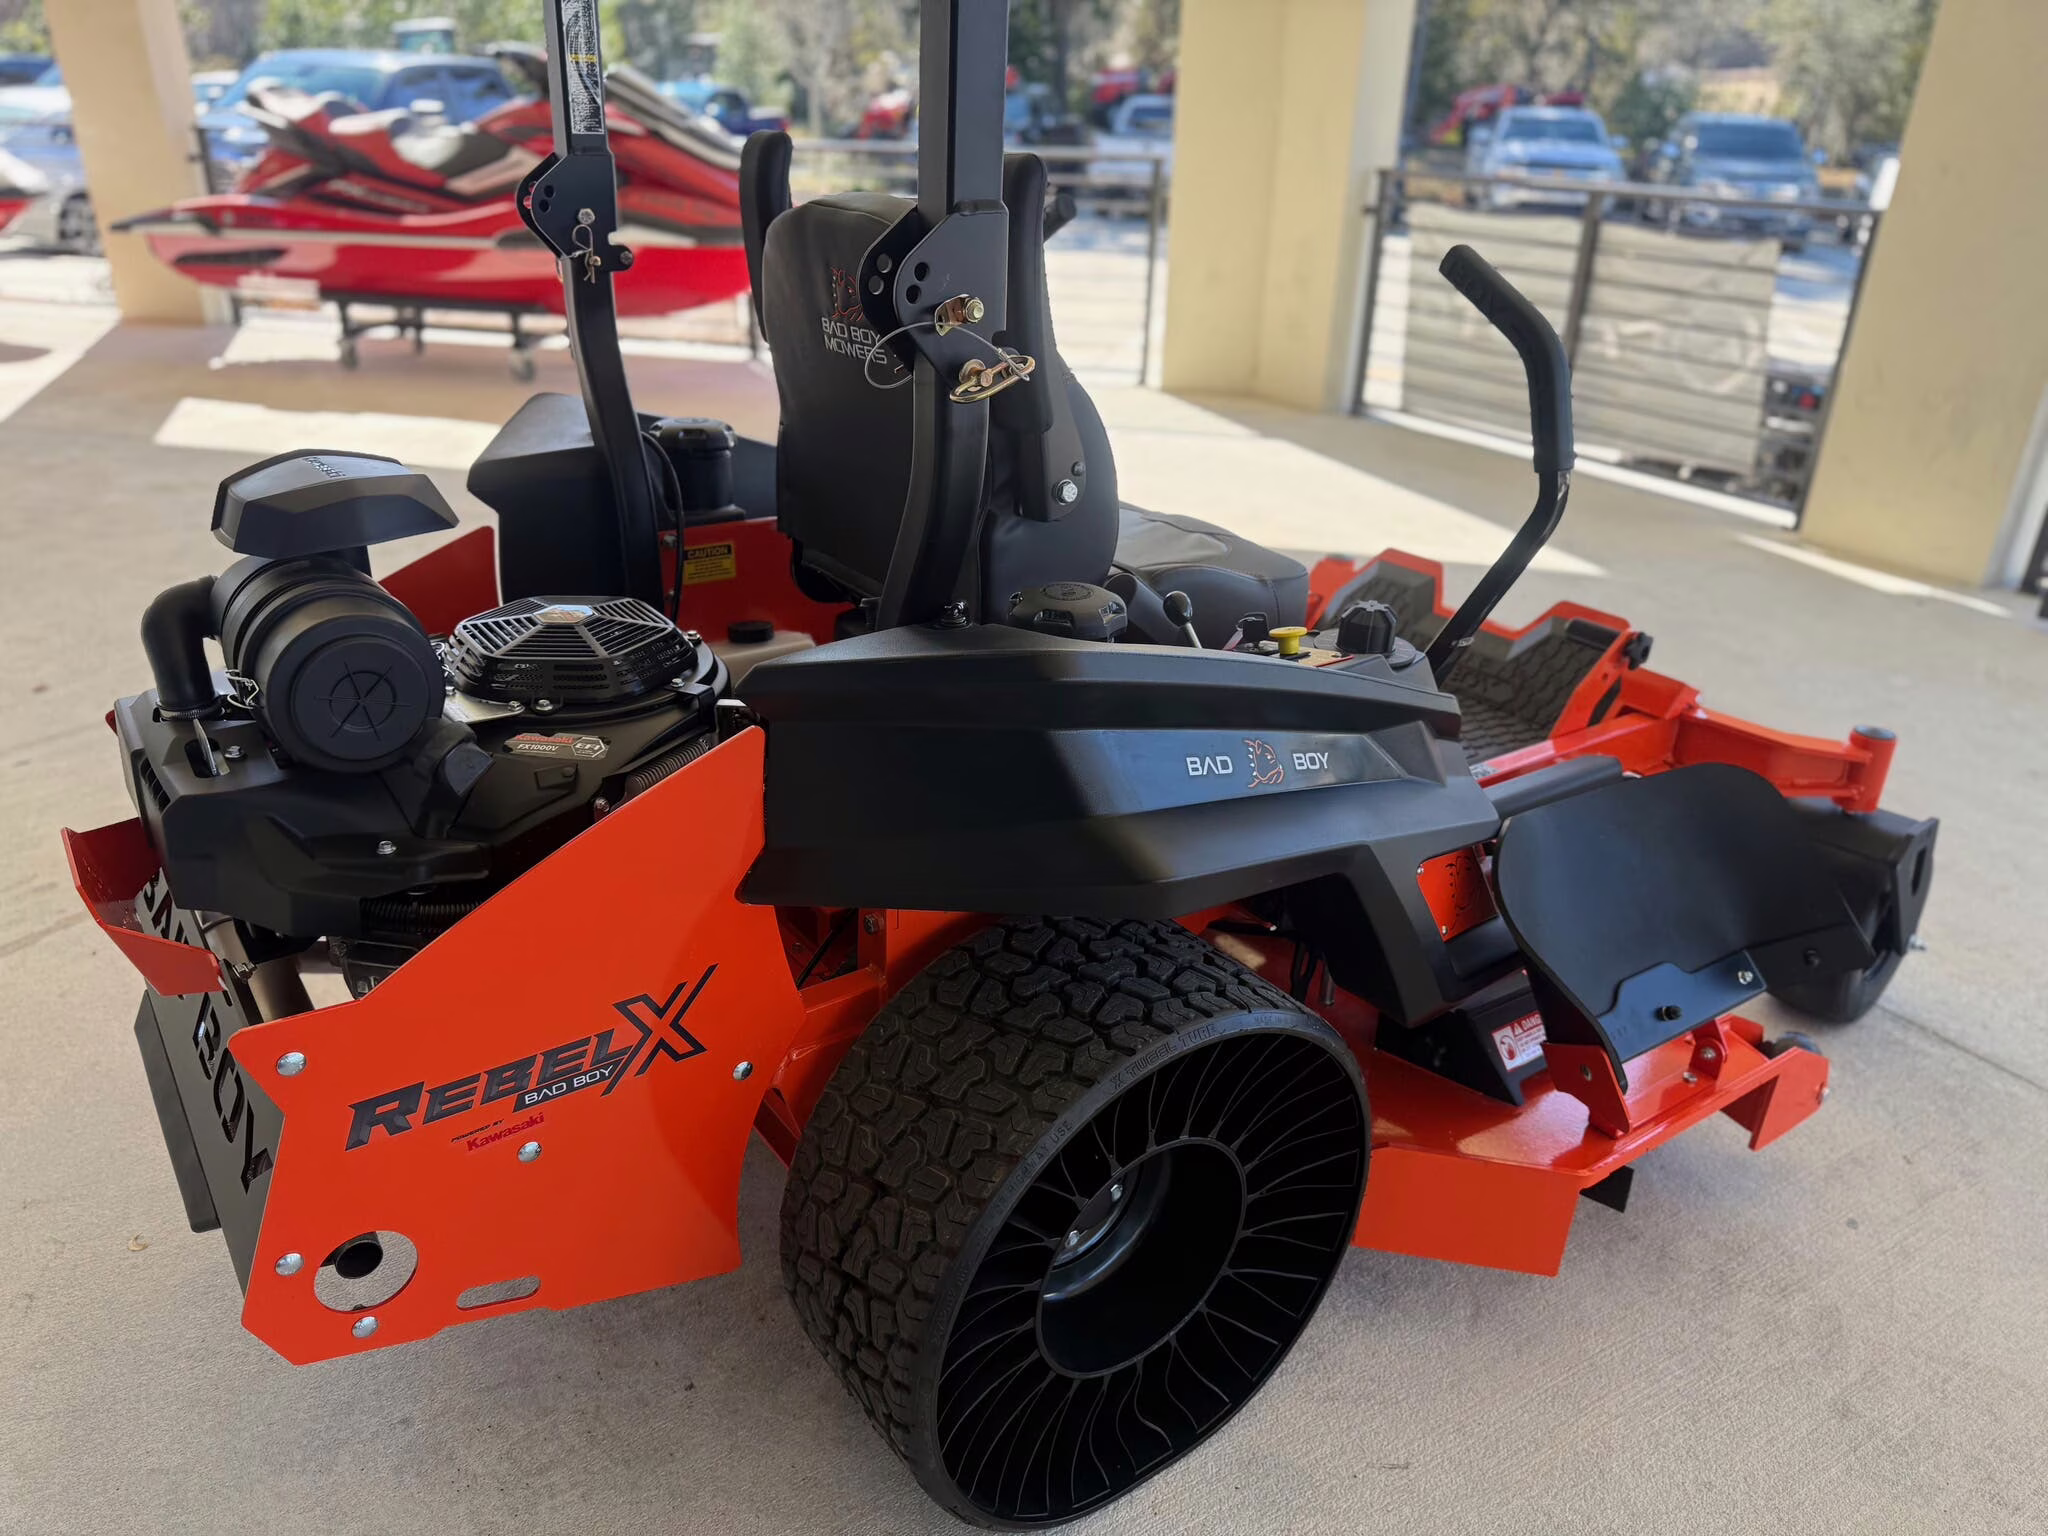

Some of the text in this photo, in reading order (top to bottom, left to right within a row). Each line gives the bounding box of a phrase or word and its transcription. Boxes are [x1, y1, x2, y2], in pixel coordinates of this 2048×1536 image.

[821, 317, 880, 345] BAD BOY
[823, 335, 887, 364] MOWERS
[516, 743, 559, 752] FX1000V
[1186, 752, 1329, 776] BAD BOY
[524, 1064, 614, 1105] BAD BOY
[466, 1112, 545, 1152] Kawasaki
